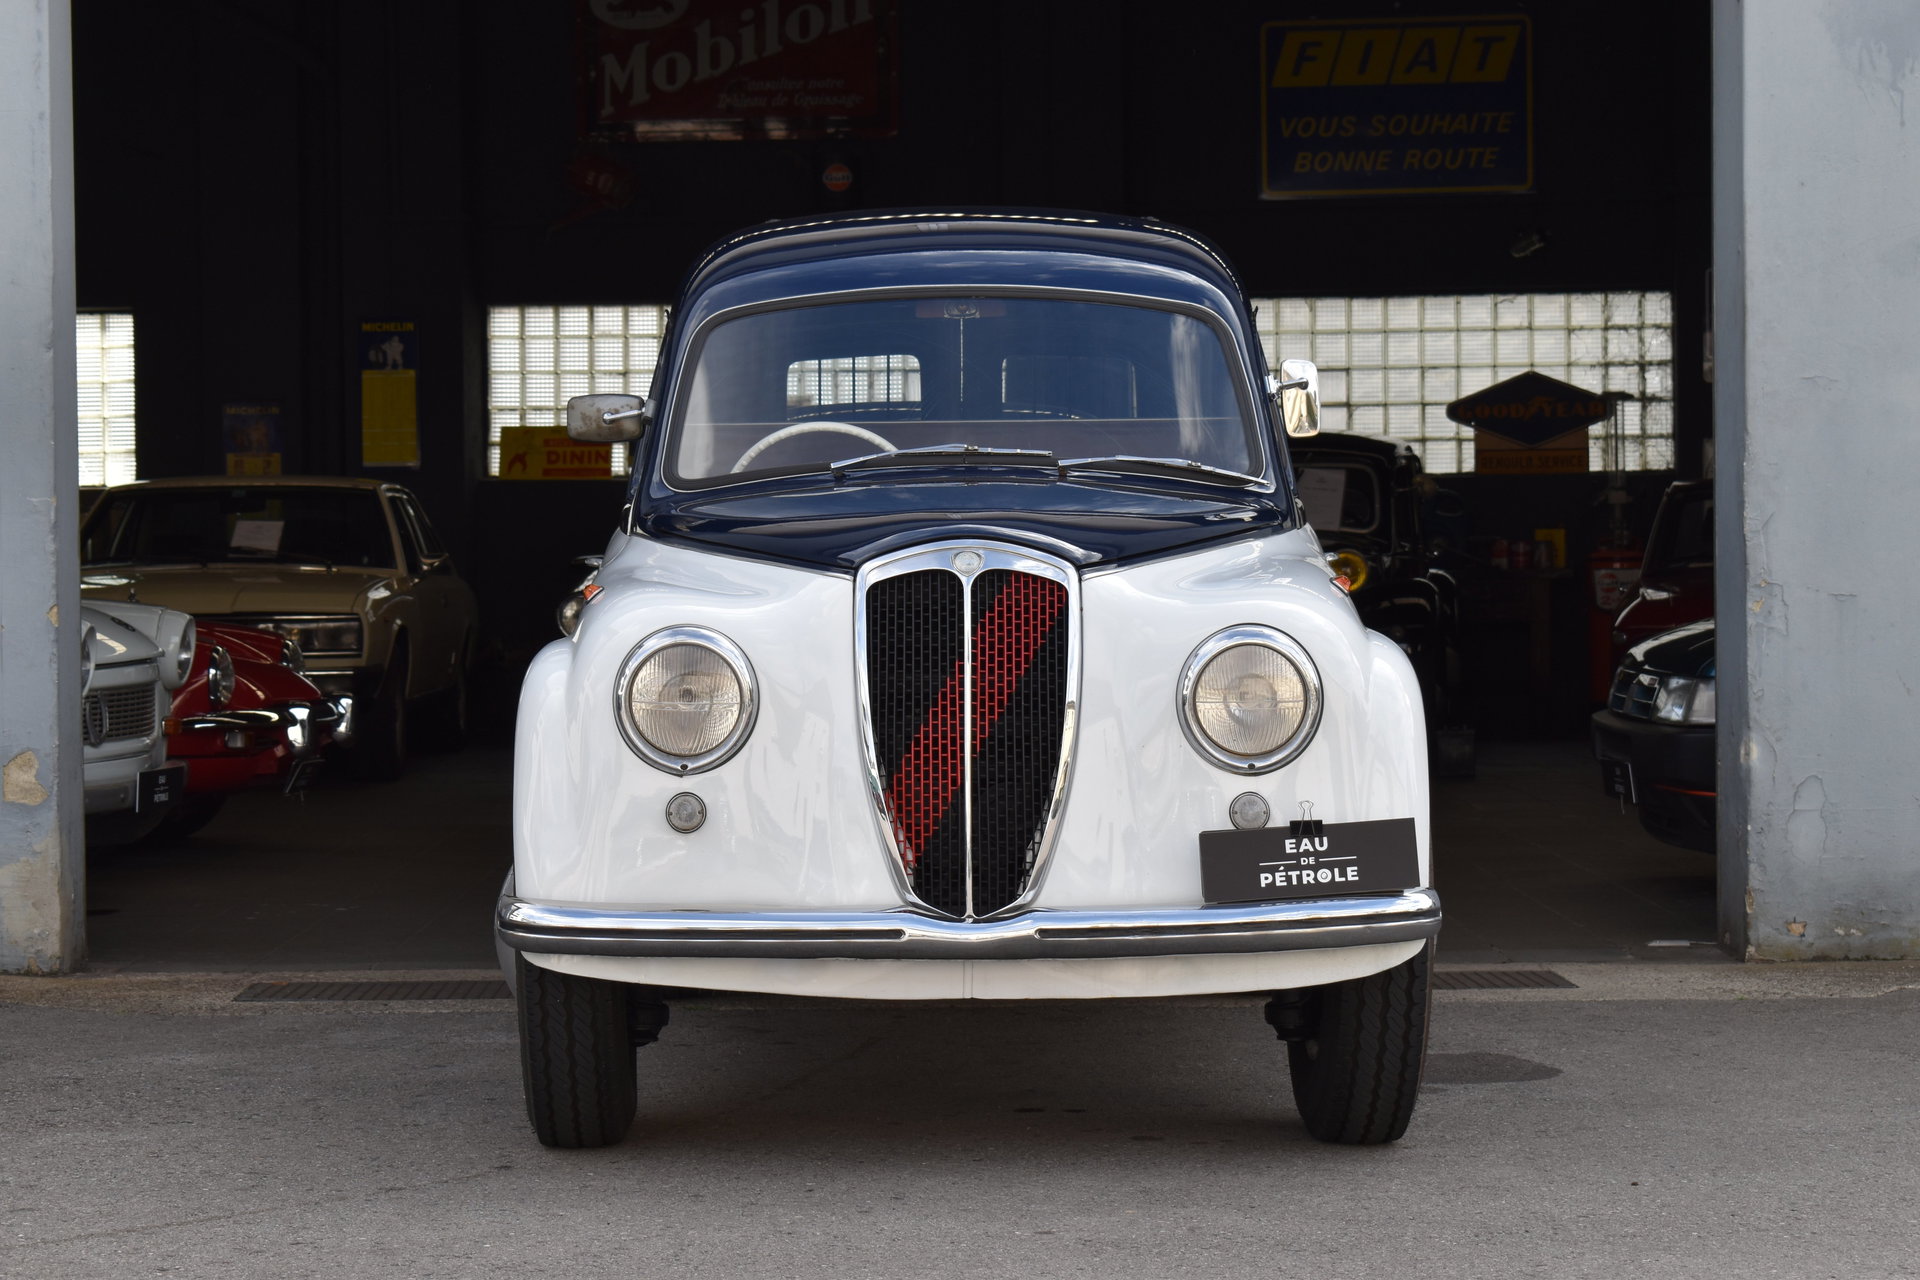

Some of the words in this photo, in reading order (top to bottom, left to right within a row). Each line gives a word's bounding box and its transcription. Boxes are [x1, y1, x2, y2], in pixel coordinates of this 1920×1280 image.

[1289, 35, 1508, 77] FIAT
[1280, 115, 1357, 138] VOUS
[1368, 112, 1515, 137] SOUHAITE
[1294, 149, 1393, 173] BONNE
[1403, 147, 1500, 170] ROUTE
[362, 321, 414, 332] MICHELIN
[1284, 836, 1329, 854] EAU
[1300, 857, 1315, 866] DE
[1259, 866, 1359, 888] PÉTROLE
